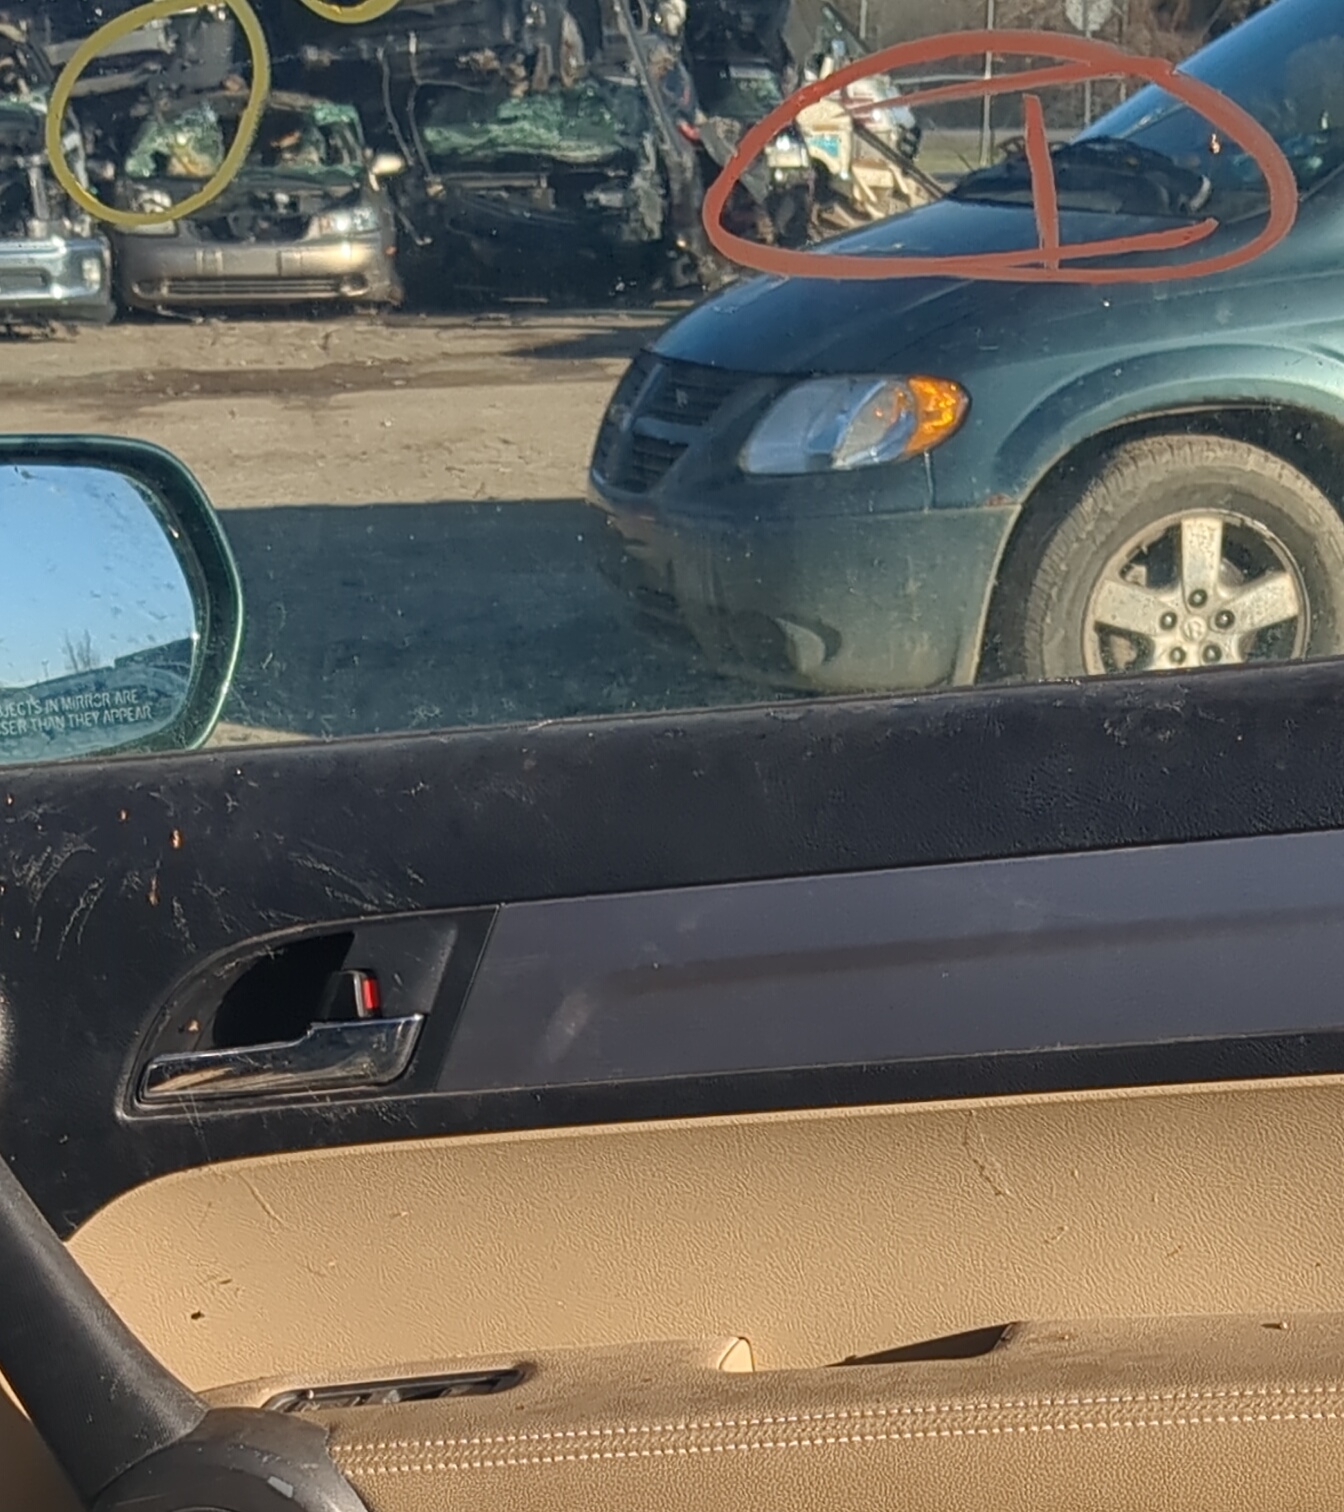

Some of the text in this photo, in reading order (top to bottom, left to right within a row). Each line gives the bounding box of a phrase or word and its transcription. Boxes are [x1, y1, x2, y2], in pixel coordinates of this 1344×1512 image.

[44, 697, 59, 714] IN
[60, 691, 110, 711] MIRROR
[114, 688, 139, 704] ARE
[31, 714, 66, 733] THAN
[67, 710, 100, 728] THEY
[102, 704, 153, 724] APPEAR
